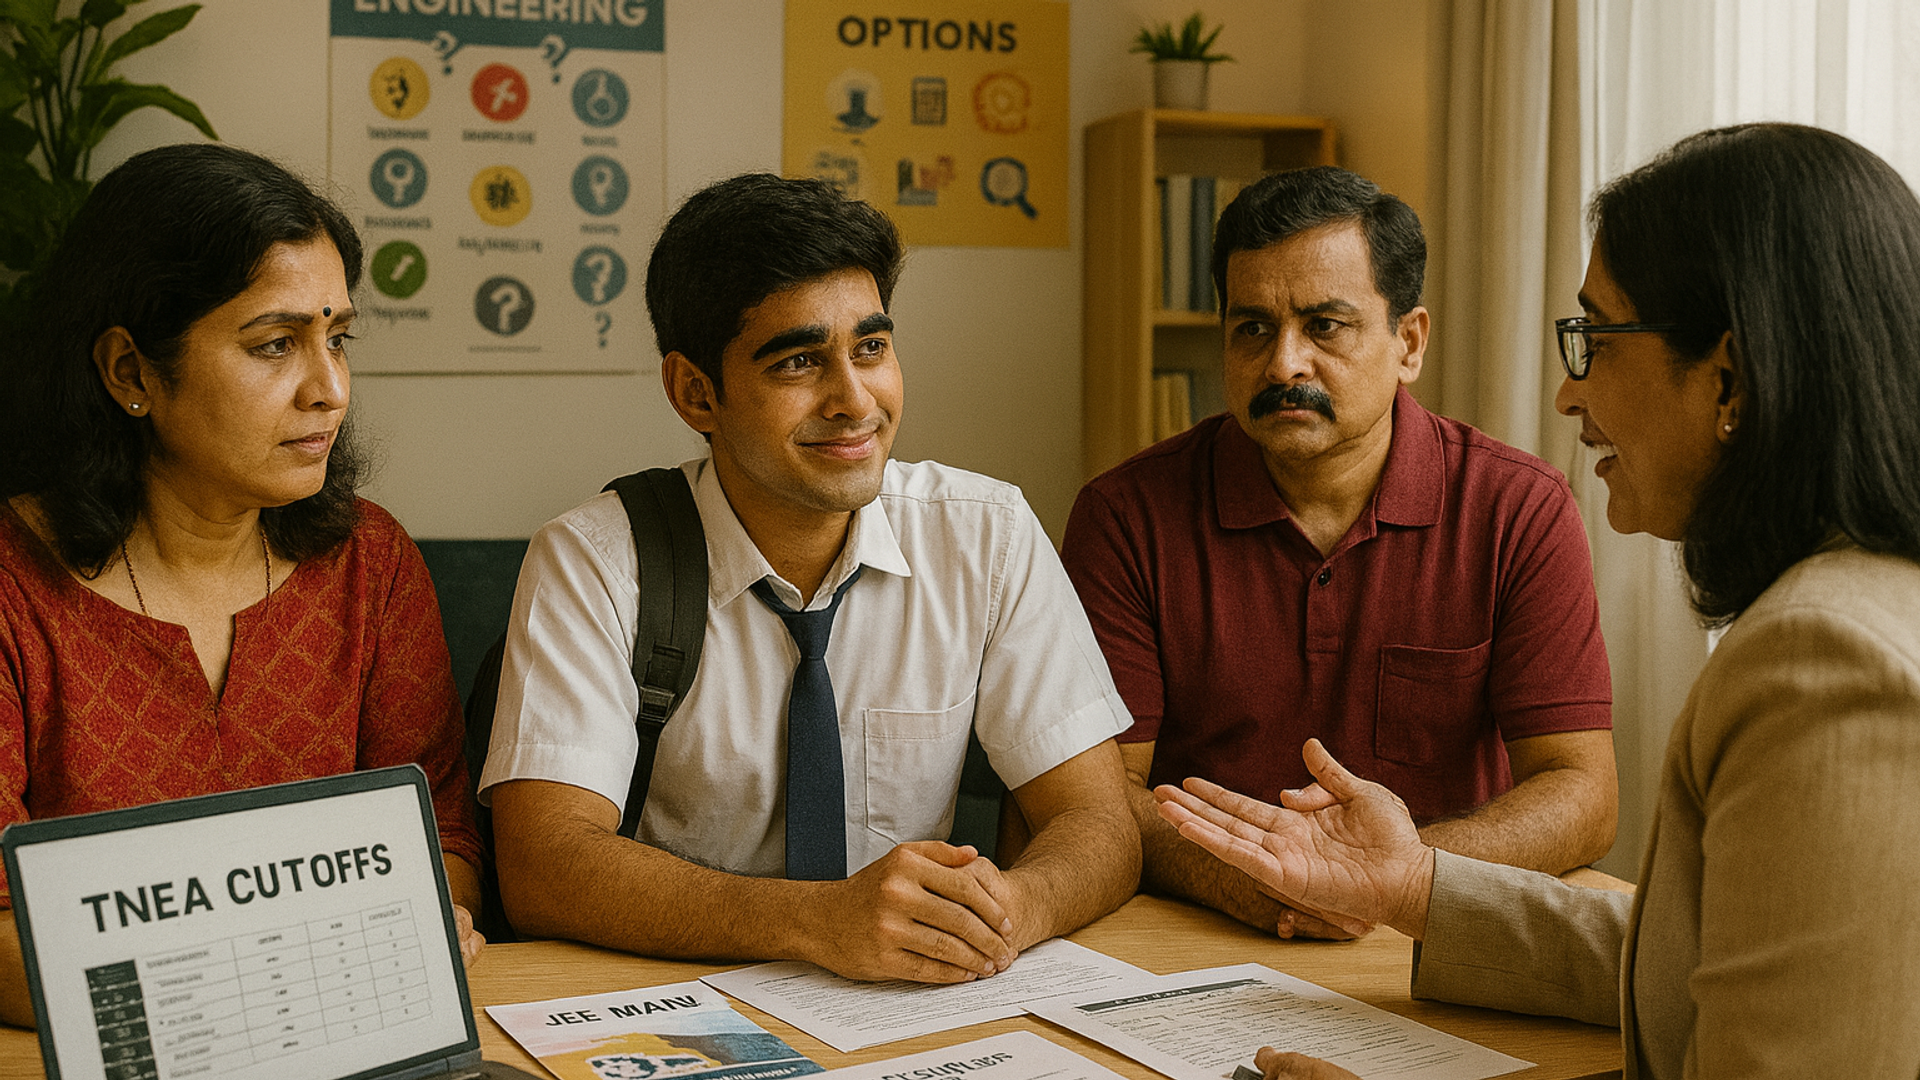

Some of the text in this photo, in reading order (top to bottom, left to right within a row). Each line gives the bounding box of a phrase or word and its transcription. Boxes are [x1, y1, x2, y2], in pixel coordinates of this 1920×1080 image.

[837, 15, 1017, 53] OPTIONS
[81, 843, 392, 933] TNEA CUTOFFS
[545, 1010, 602, 1026] JEE
